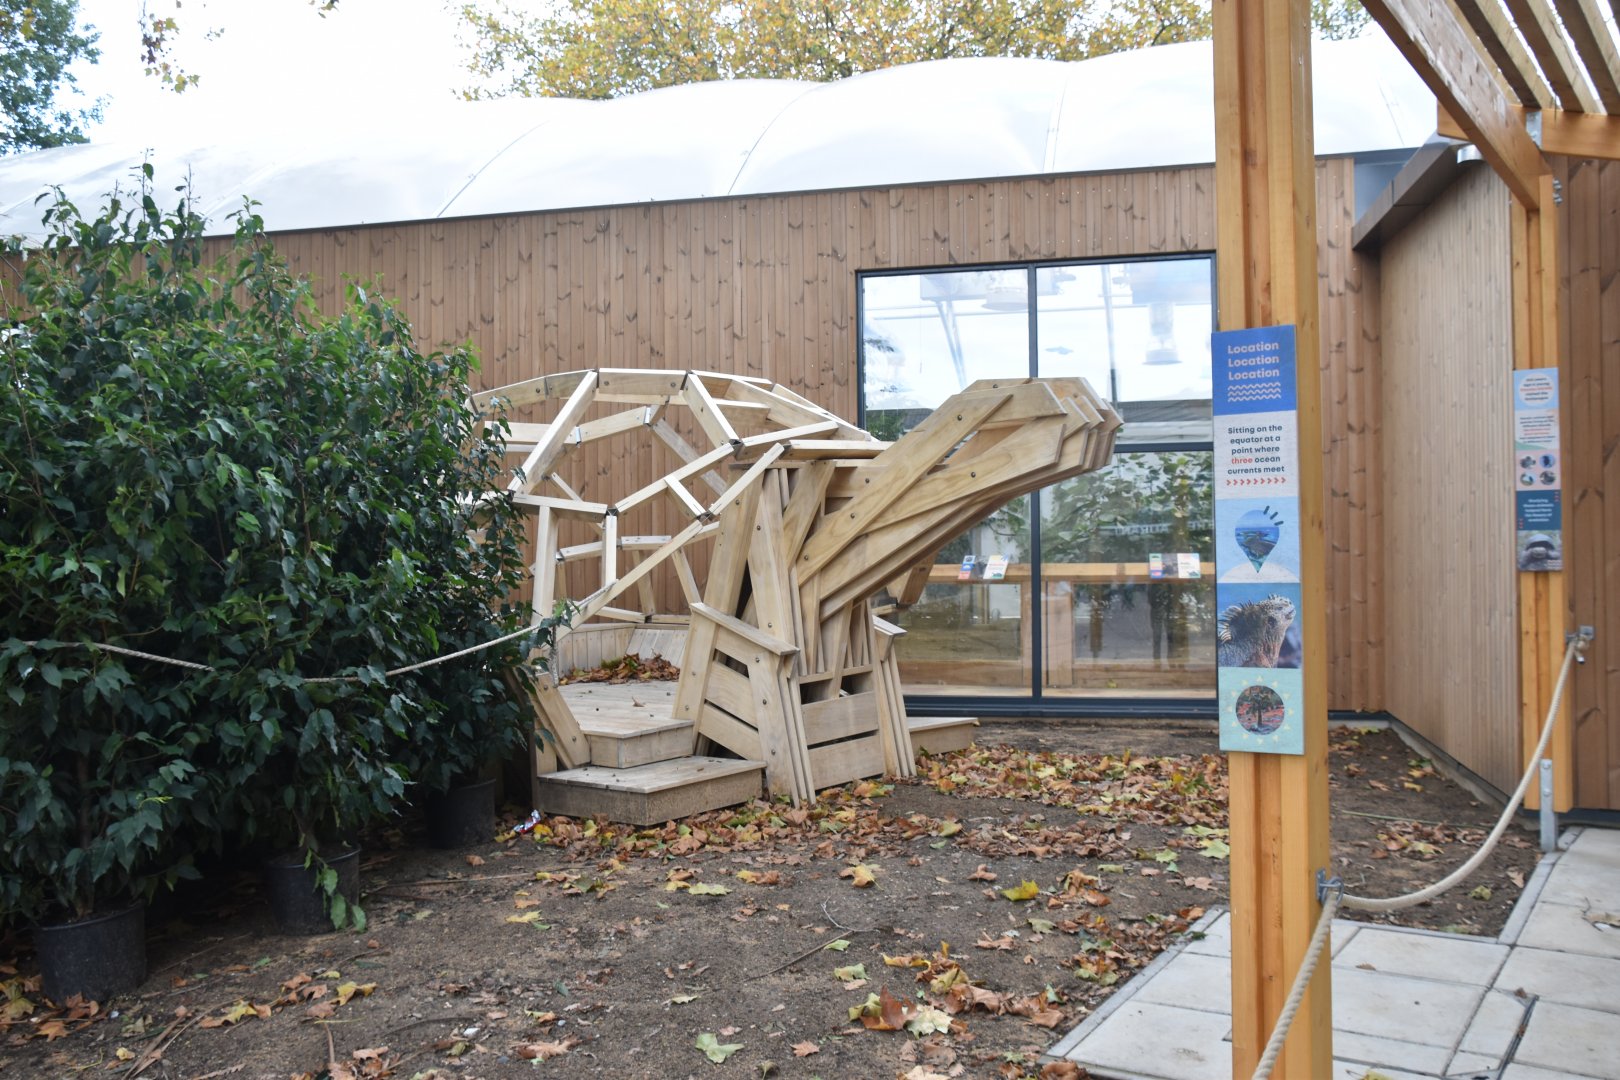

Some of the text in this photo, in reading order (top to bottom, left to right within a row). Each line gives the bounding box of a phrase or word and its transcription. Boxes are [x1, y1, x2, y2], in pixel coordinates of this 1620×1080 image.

[1228, 341, 1279, 354] Location
[1228, 355, 1280, 368] Location
[1228, 367, 1280, 381] Location
[1227, 426, 1255, 434] Sitting
[1230, 437, 1263, 445] equator
[1231, 447, 1253, 455] point
[1227, 465, 1285, 475] currents meet
